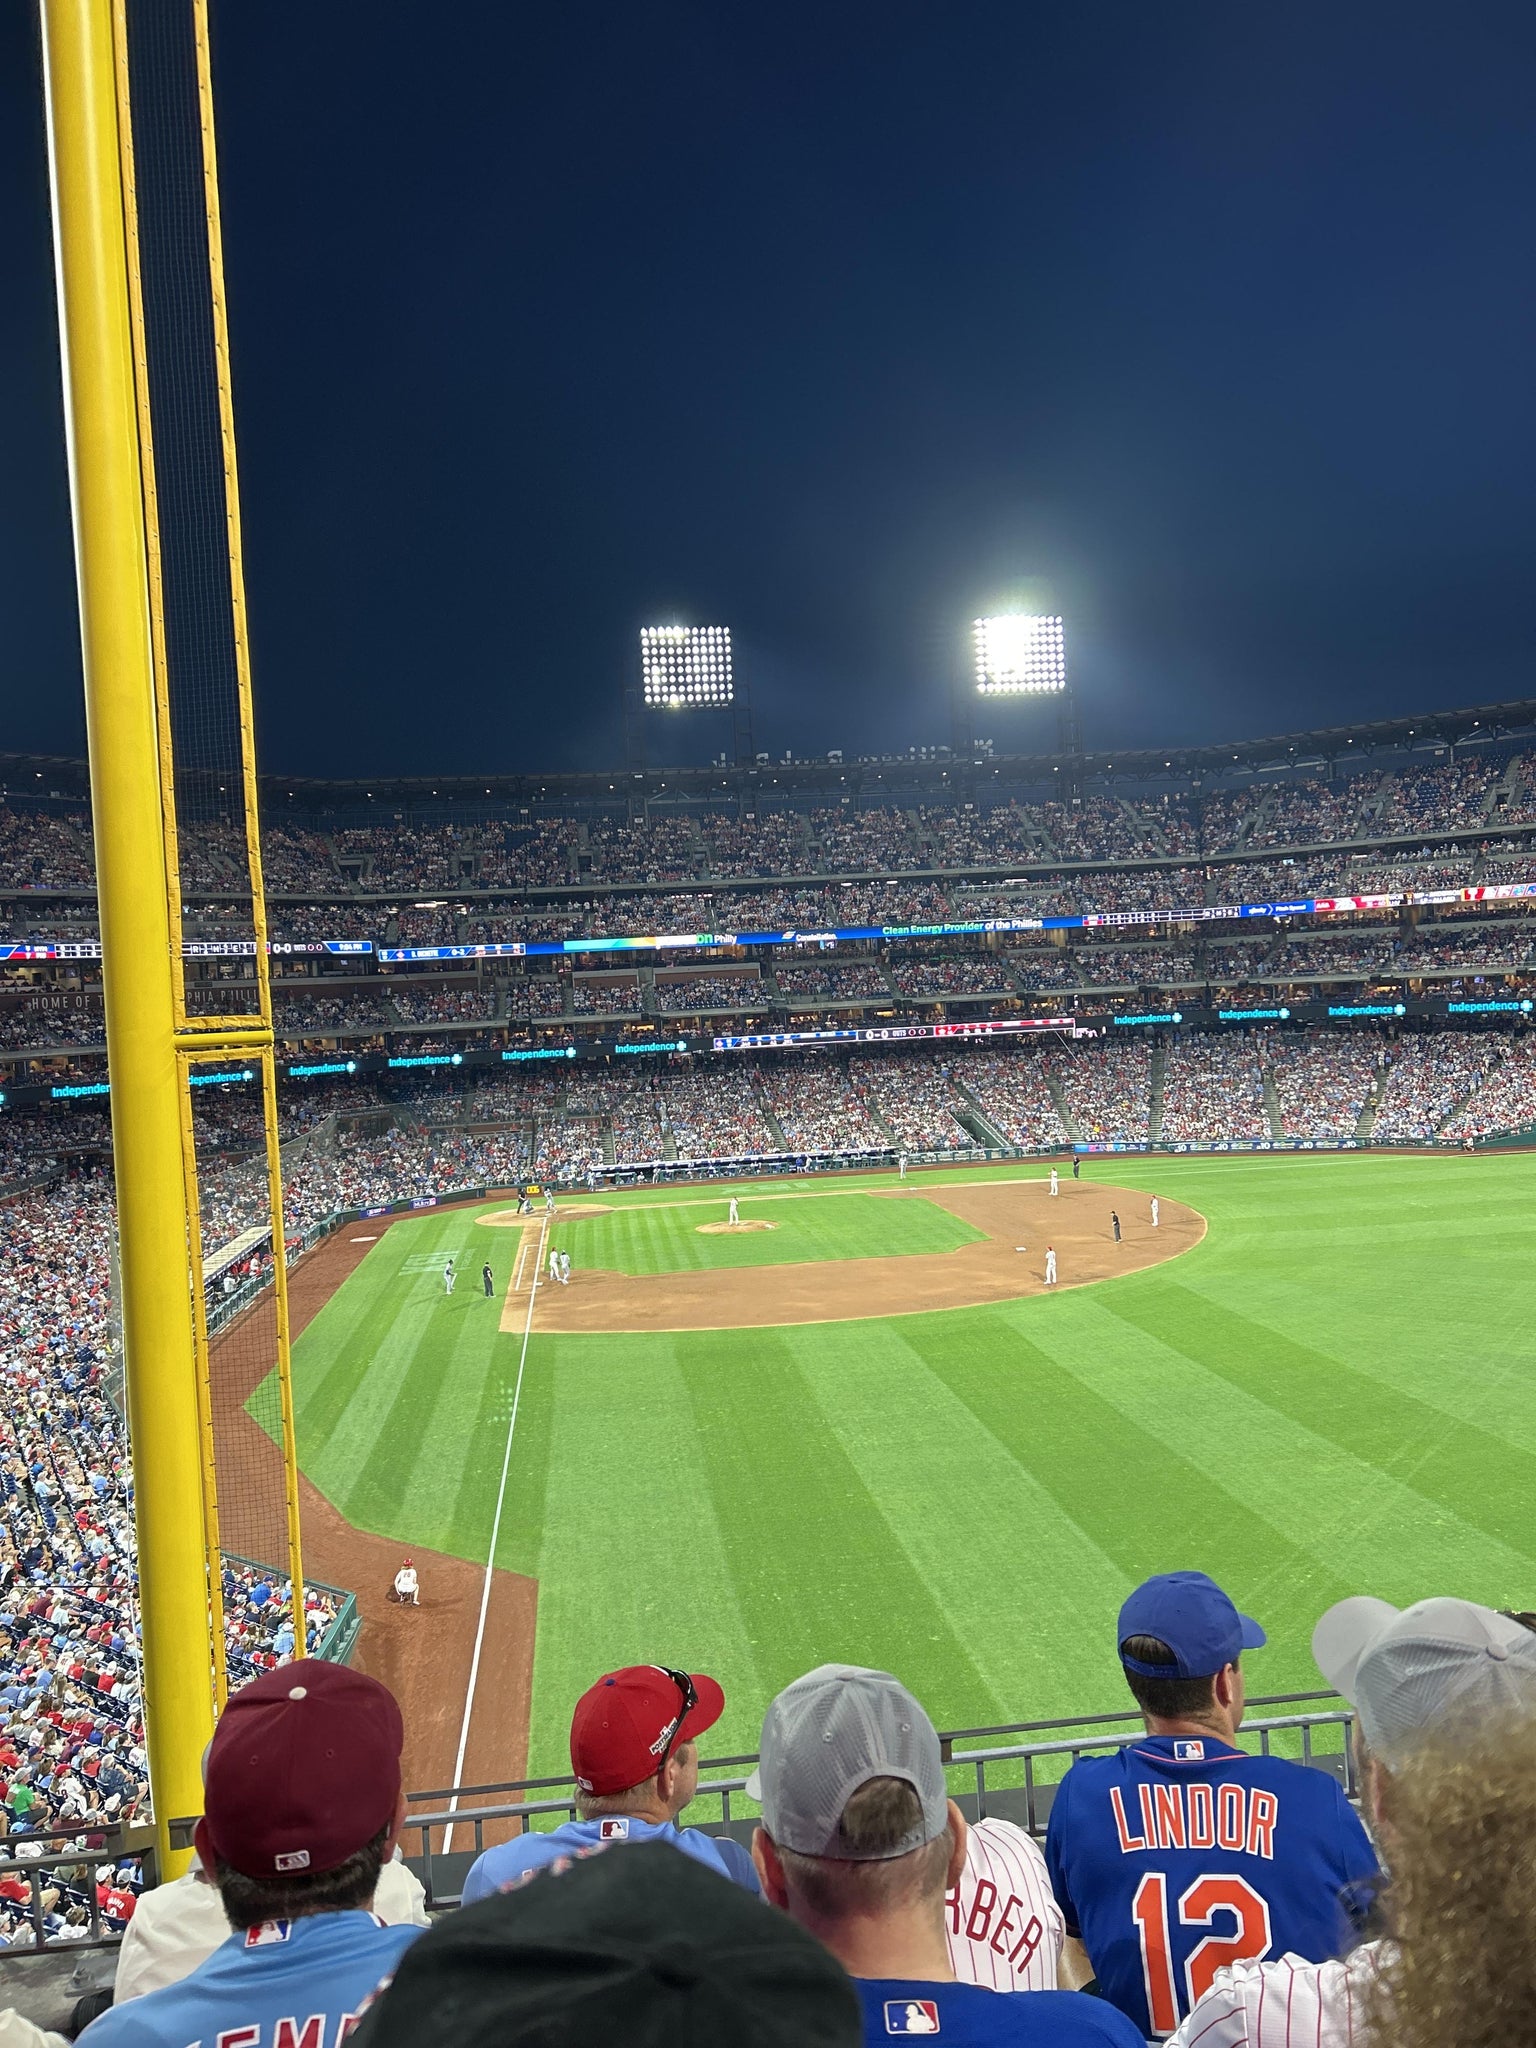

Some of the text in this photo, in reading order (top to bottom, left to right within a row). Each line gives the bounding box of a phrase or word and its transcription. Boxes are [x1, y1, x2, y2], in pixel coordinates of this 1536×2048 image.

[883, 918, 1043, 935] Clean Energy Provider of the Phillies
[714, 933, 738, 946] Philly
[192, 944, 199, 953] R
[232, 944, 239, 953] E
[32, 996, 68, 1010] HOME
[75, 995, 90, 1008] OF
[1448, 1000, 1520, 1014] Independence
[1219, 1008, 1278, 1020] Independence
[1328, 1004, 1393, 1017] Independence
[1114, 1013, 1172, 1026] Independence
[502, 1048, 565, 1061] Independence
[615, 1042, 675, 1054] Independence
[388, 1055, 450, 1068] Independence
[290, 1063, 346, 1077] Independence
[1110, 1783, 1279, 1860] LINDOR
[1132, 1872, 1274, 2038] 12
